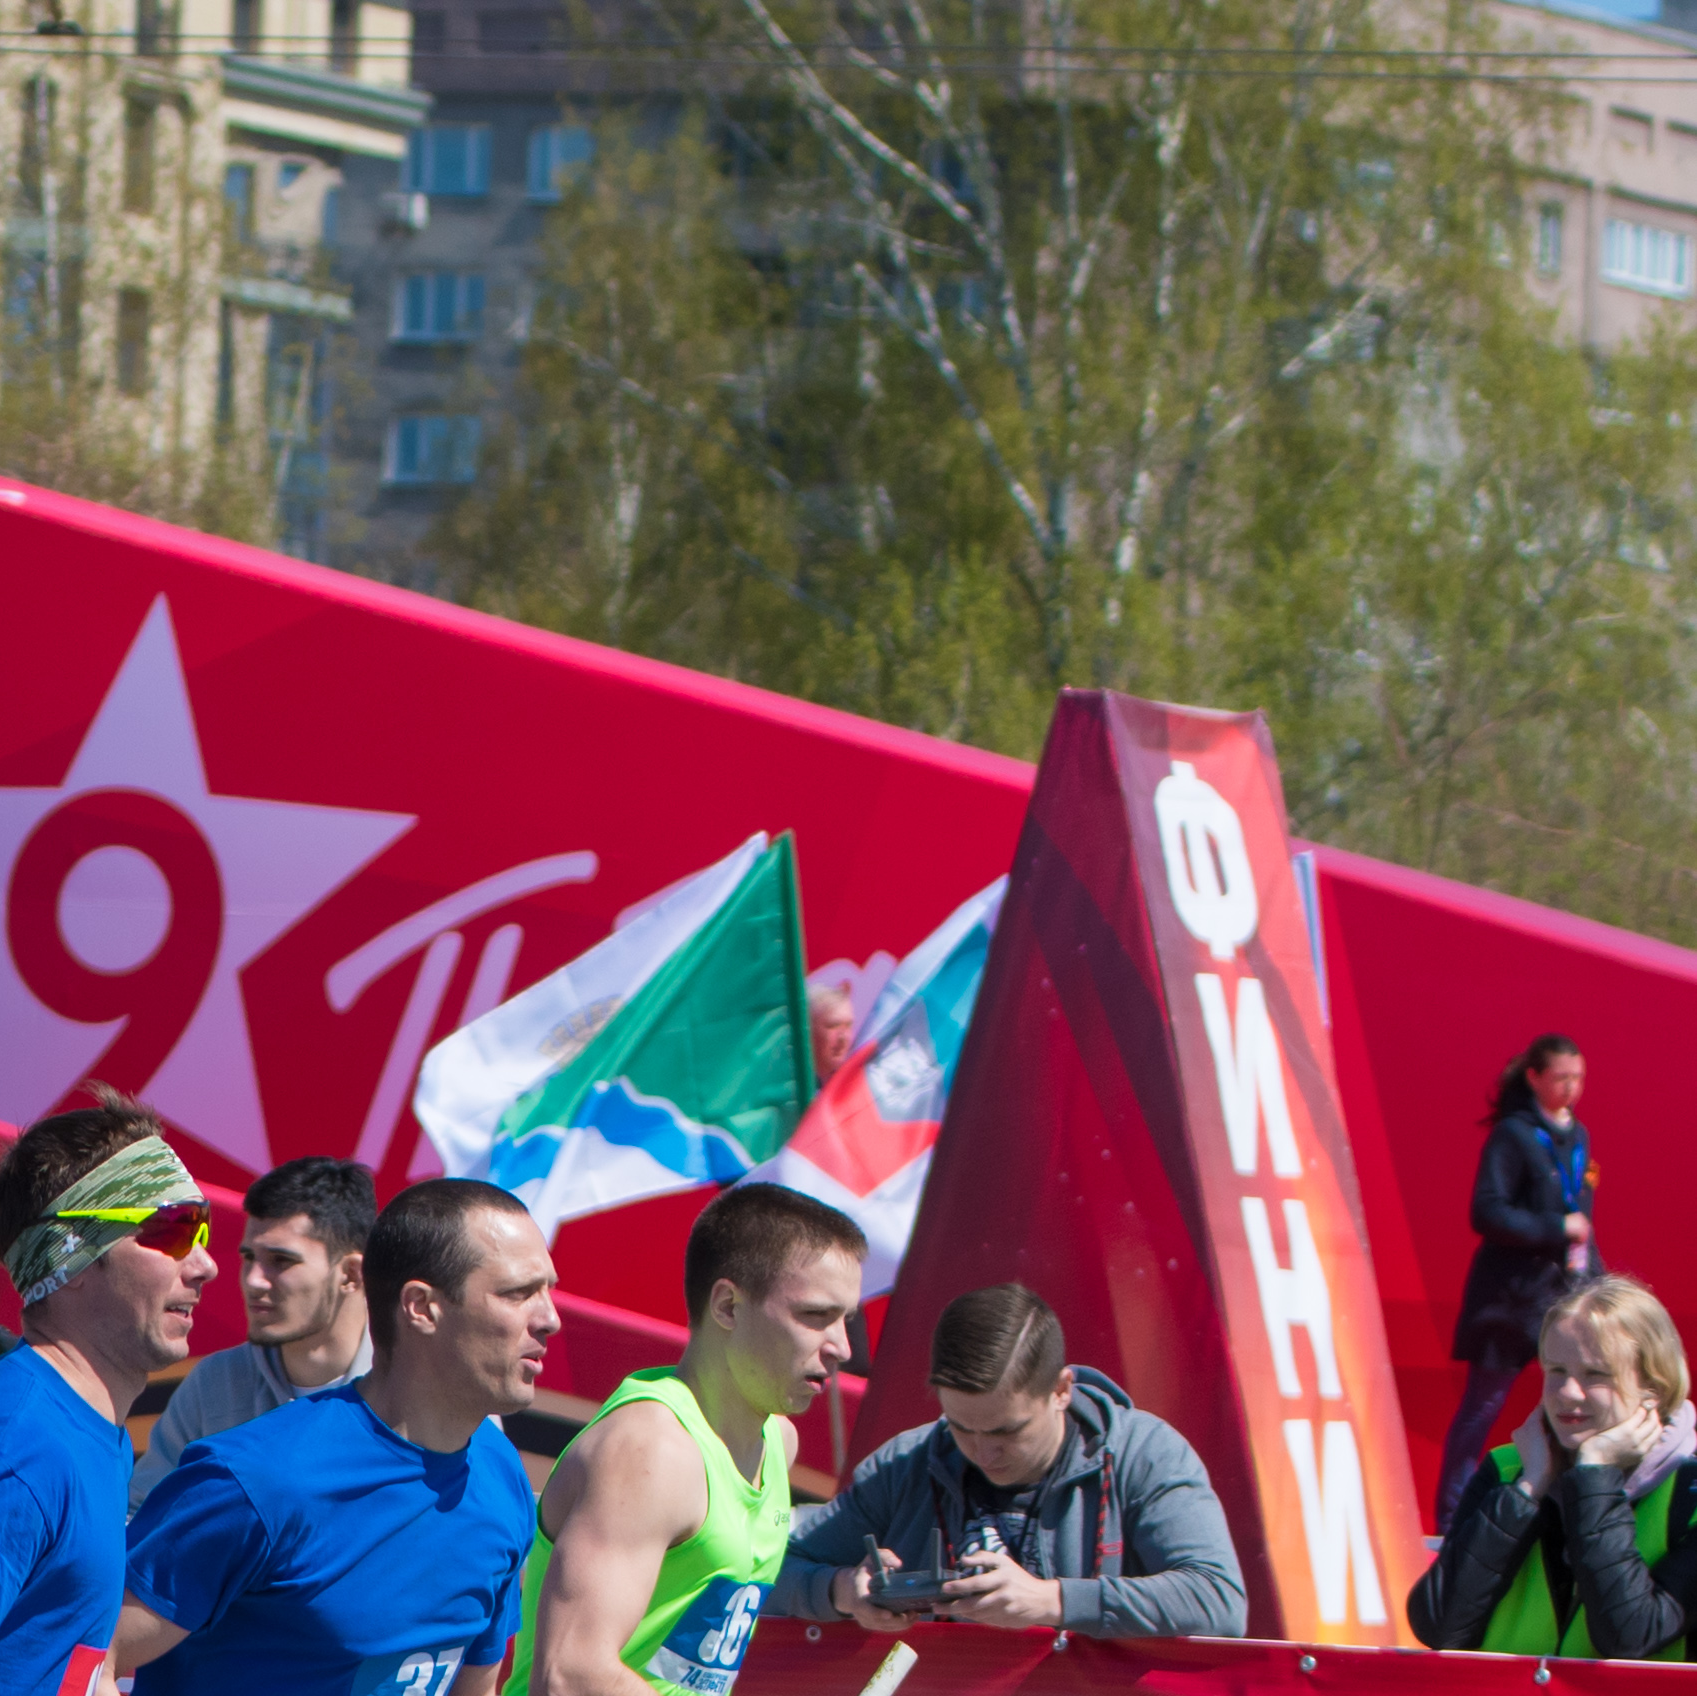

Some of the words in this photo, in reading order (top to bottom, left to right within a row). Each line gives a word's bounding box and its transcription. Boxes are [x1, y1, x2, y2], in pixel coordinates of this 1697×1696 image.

[6, 786, 225, 1105] 9
[698, 1584, 761, 1666] 36
[680, 1665, 702, 1687] 74
